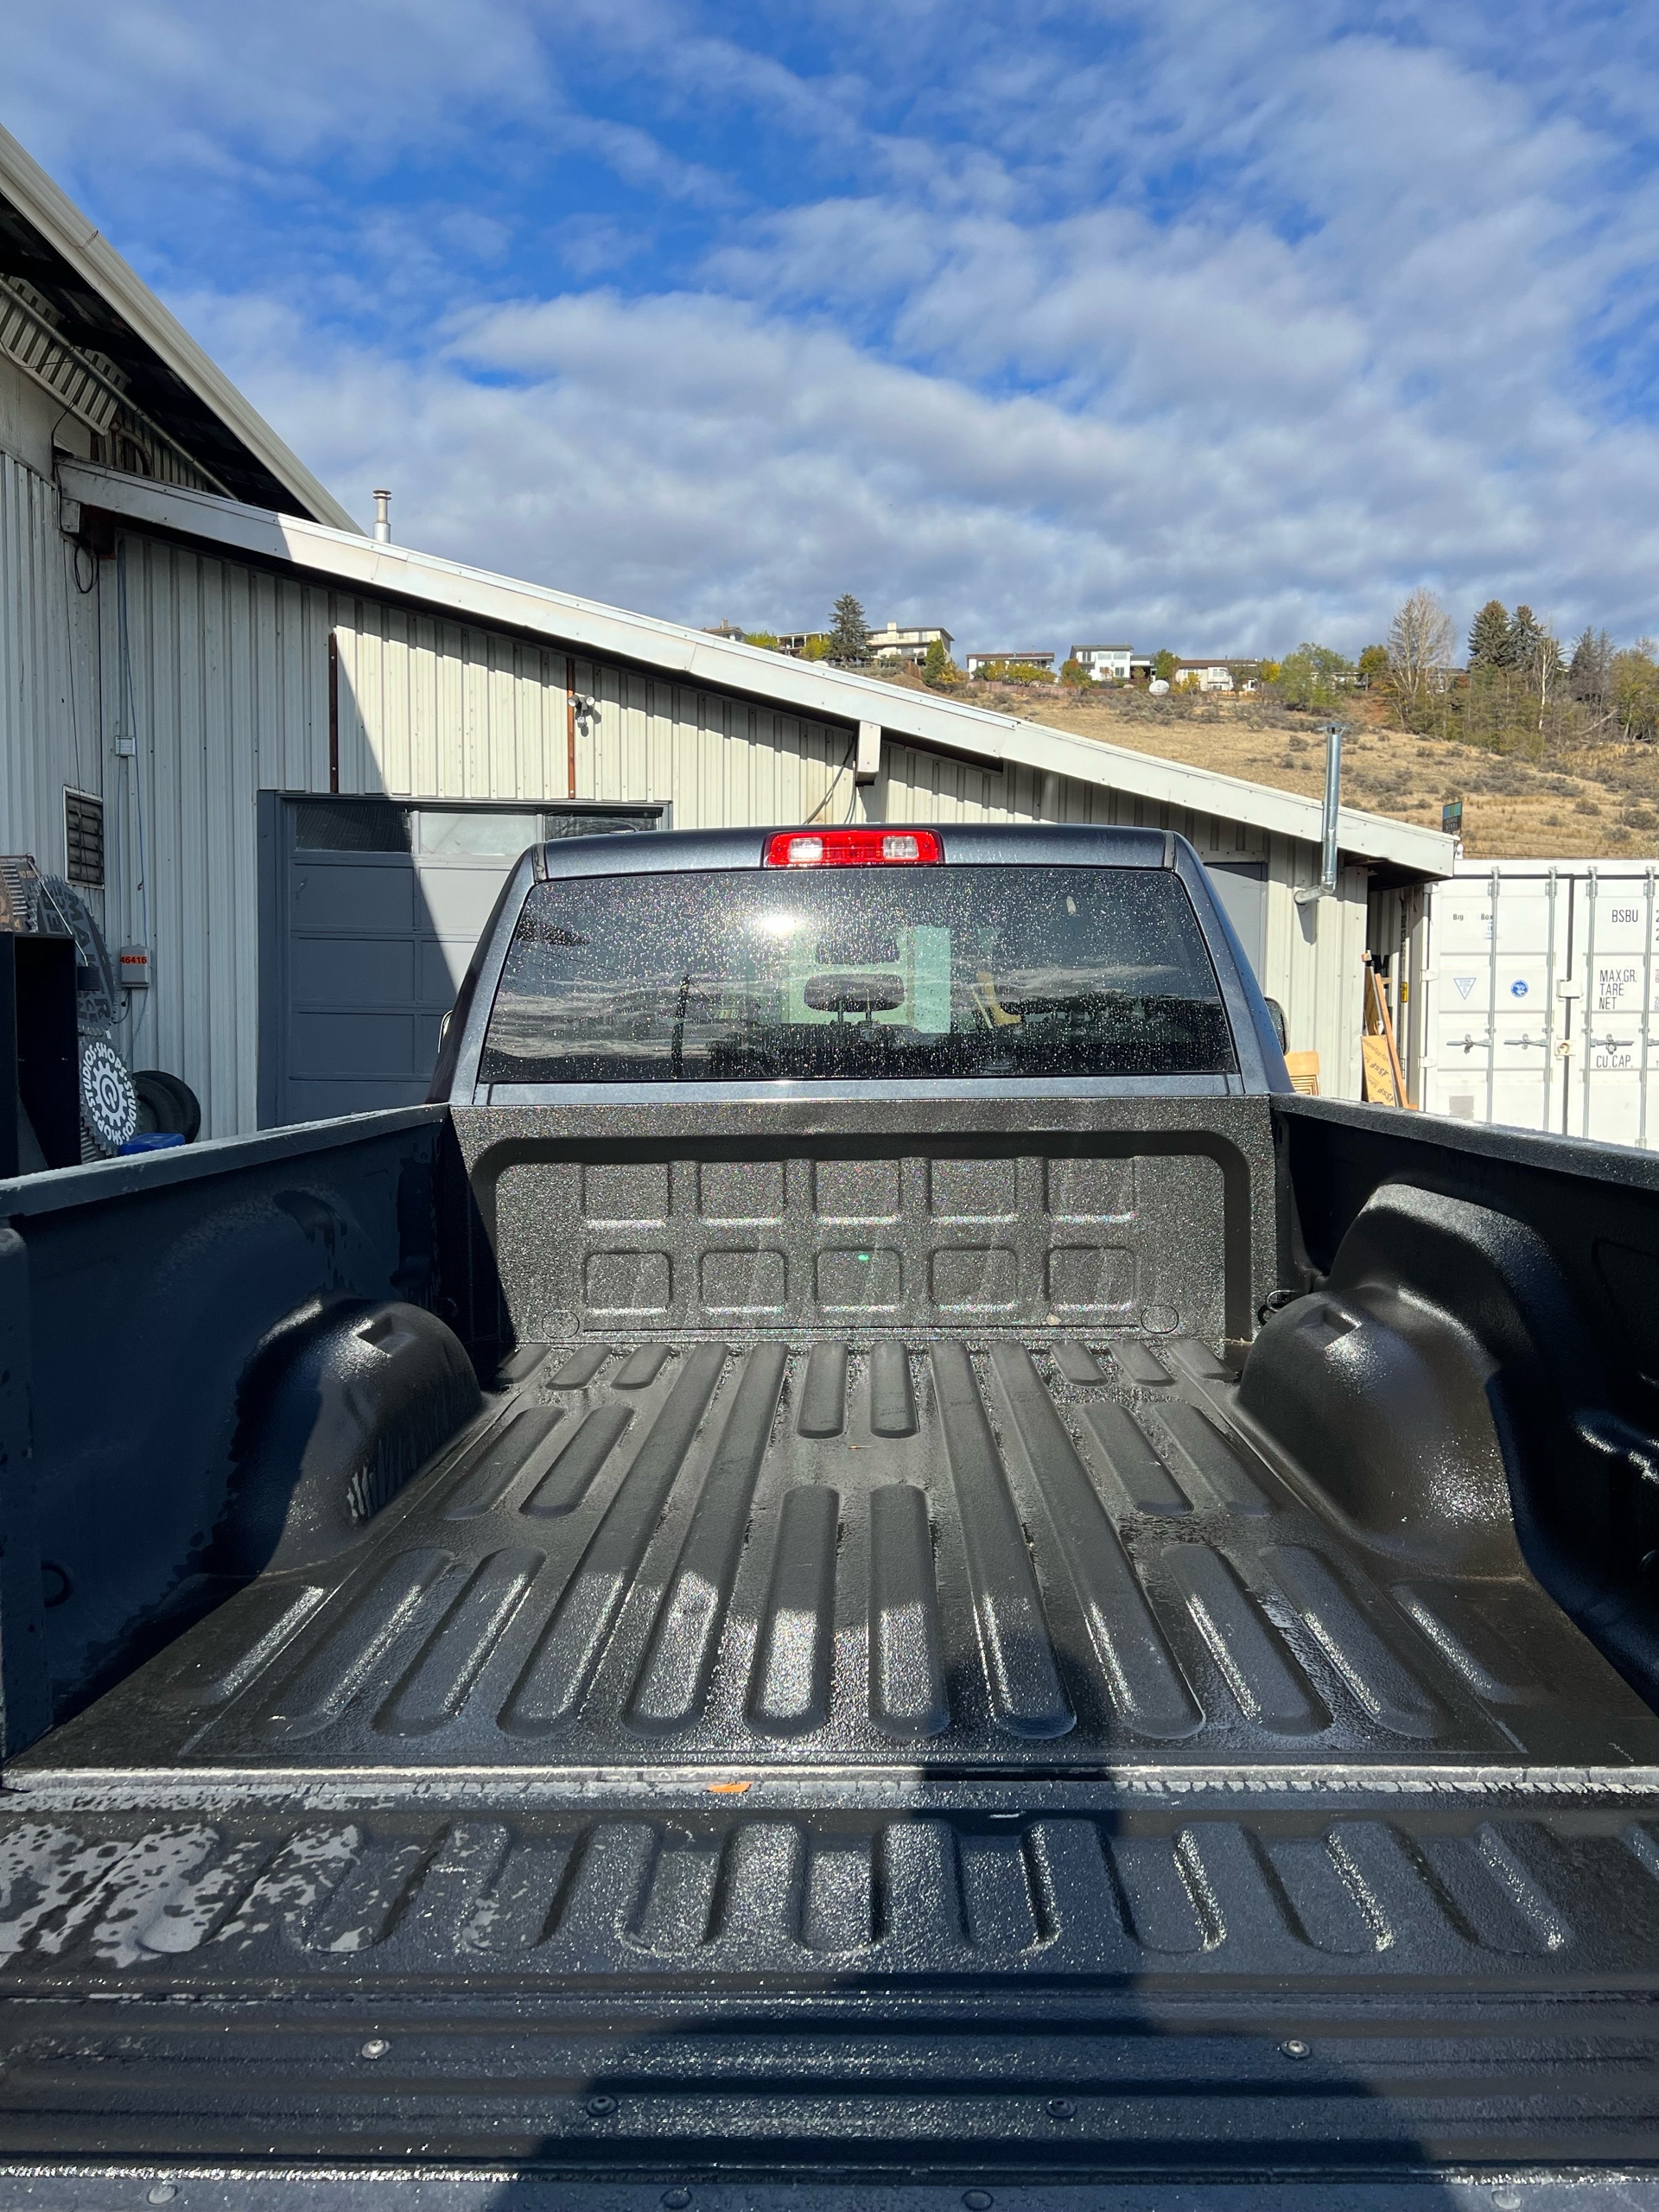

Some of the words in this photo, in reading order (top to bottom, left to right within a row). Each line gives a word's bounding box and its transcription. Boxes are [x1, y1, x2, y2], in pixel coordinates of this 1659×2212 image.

[1611, 909, 1638, 923] BSBU
[120, 956, 147, 964] 46416
[1599, 983, 1624, 996] TARE
[1599, 996, 1617, 1010] NET
